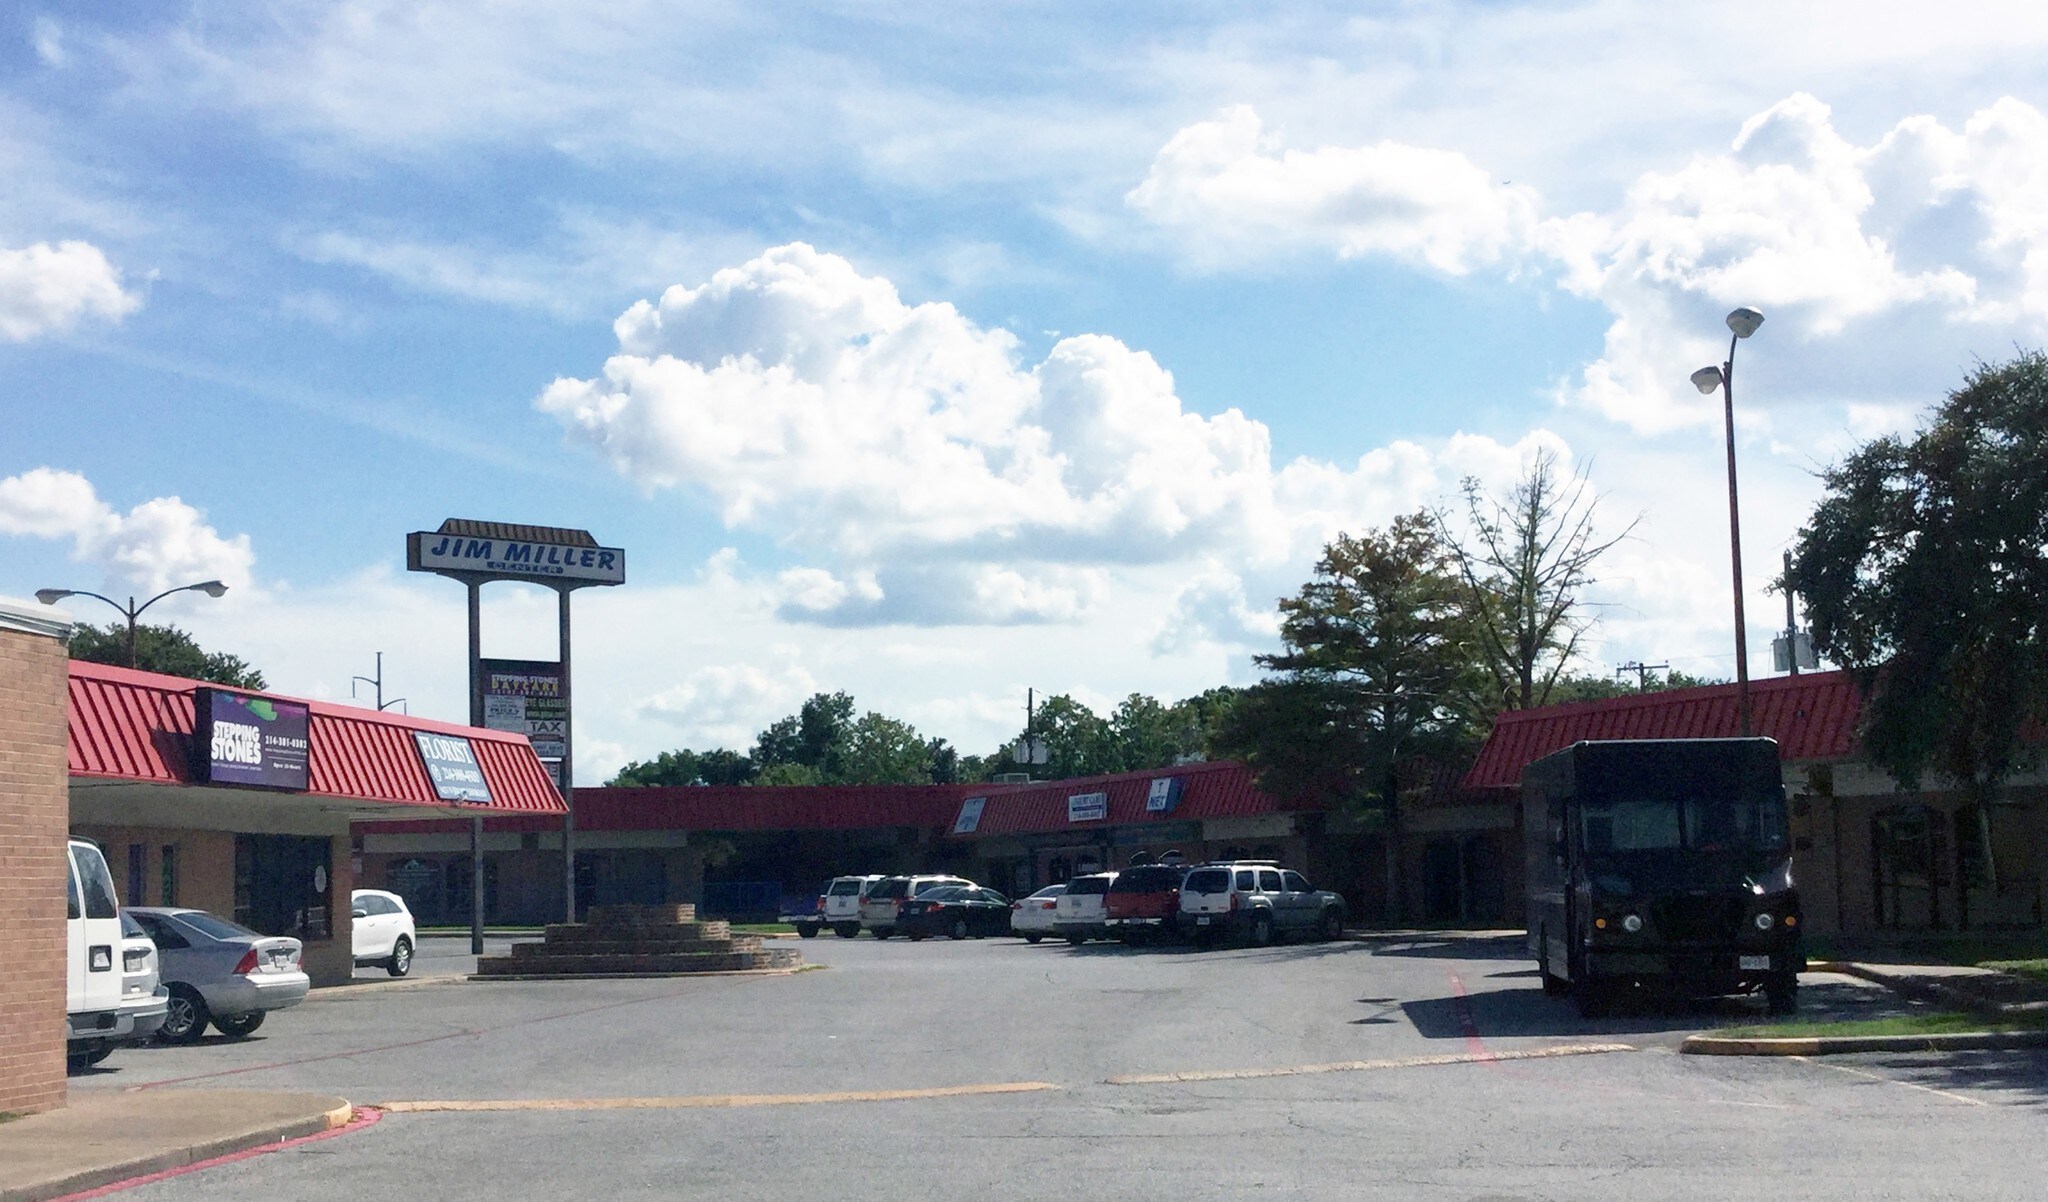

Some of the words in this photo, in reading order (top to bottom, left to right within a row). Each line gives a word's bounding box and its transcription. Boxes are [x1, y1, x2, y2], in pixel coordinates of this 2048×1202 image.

[431, 537, 493, 560] JIM
[504, 542, 615, 571] MILLER
[213, 720, 261, 743] STEPPING
[530, 721, 562, 732] TAX
[211, 737, 262, 765] STONES
[417, 735, 473, 764] FLORIST
